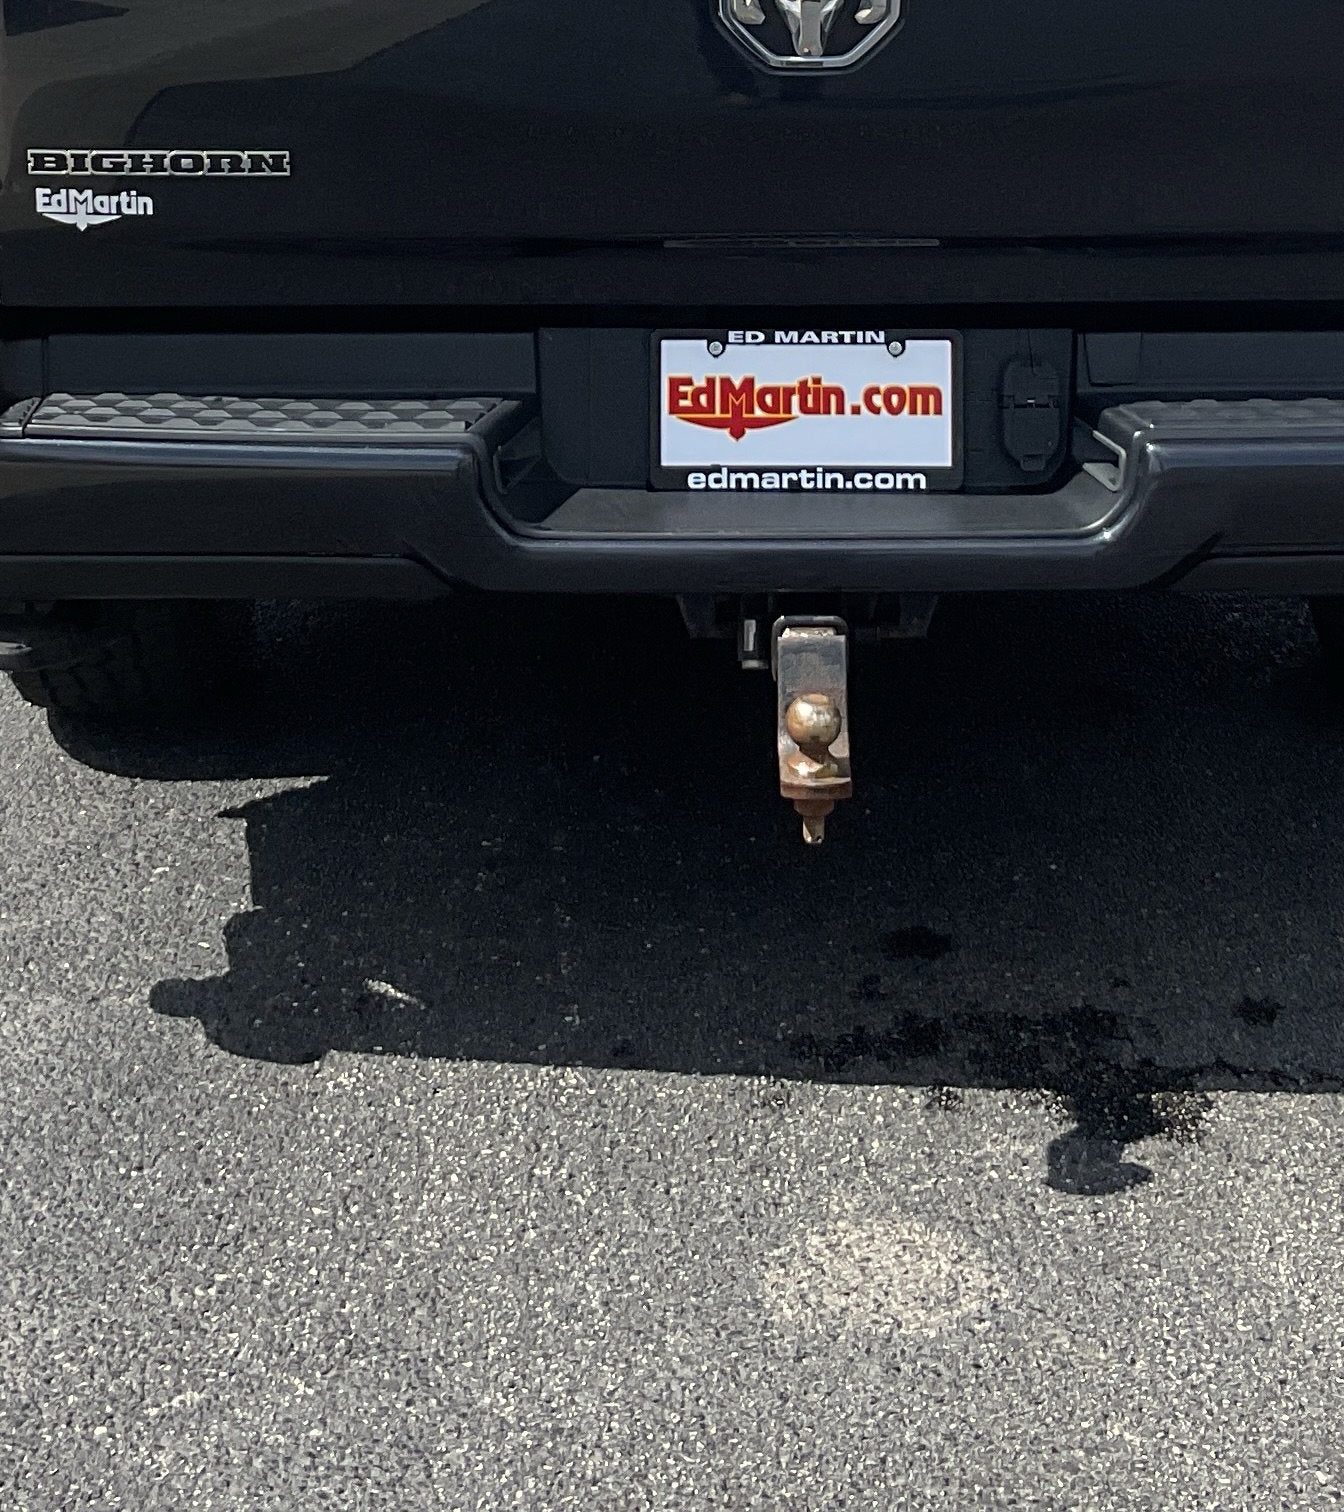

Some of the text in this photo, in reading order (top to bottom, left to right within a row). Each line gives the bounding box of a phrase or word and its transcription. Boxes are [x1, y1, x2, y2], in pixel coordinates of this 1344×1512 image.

[27, 149, 291, 176] BIGHORN
[35, 187, 154, 216] EdMartin
[727, 330, 886, 344] ED MARTIN
[687, 467, 927, 491] edmartin.com
